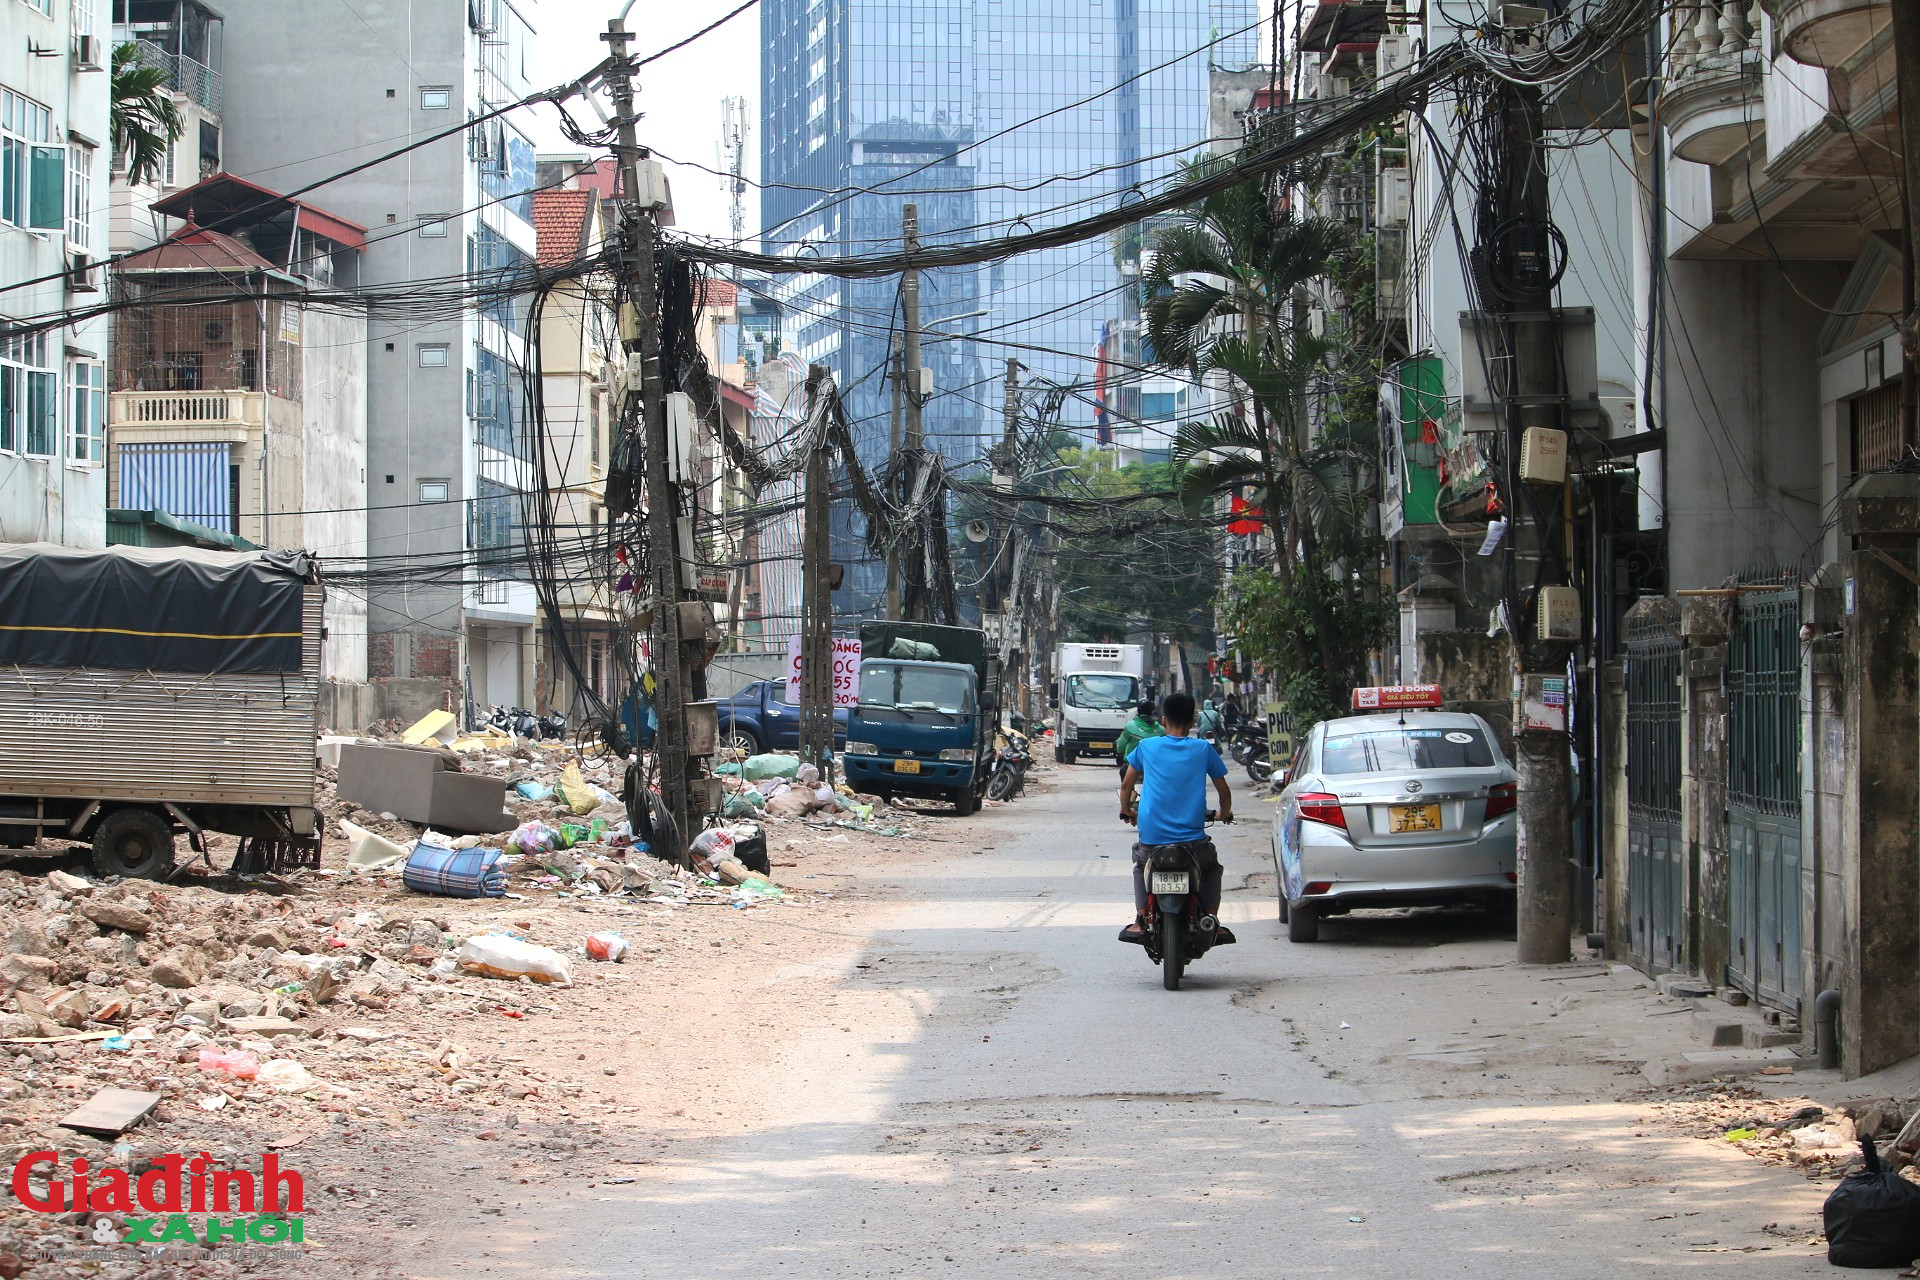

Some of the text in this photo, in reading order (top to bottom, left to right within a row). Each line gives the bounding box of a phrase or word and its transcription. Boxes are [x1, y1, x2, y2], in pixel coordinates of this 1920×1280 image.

[1416, 691, 1429, 699] TỐT
[1404, 806, 1426, 818] 29E
[1396, 818, 1436, 831] 371.34
